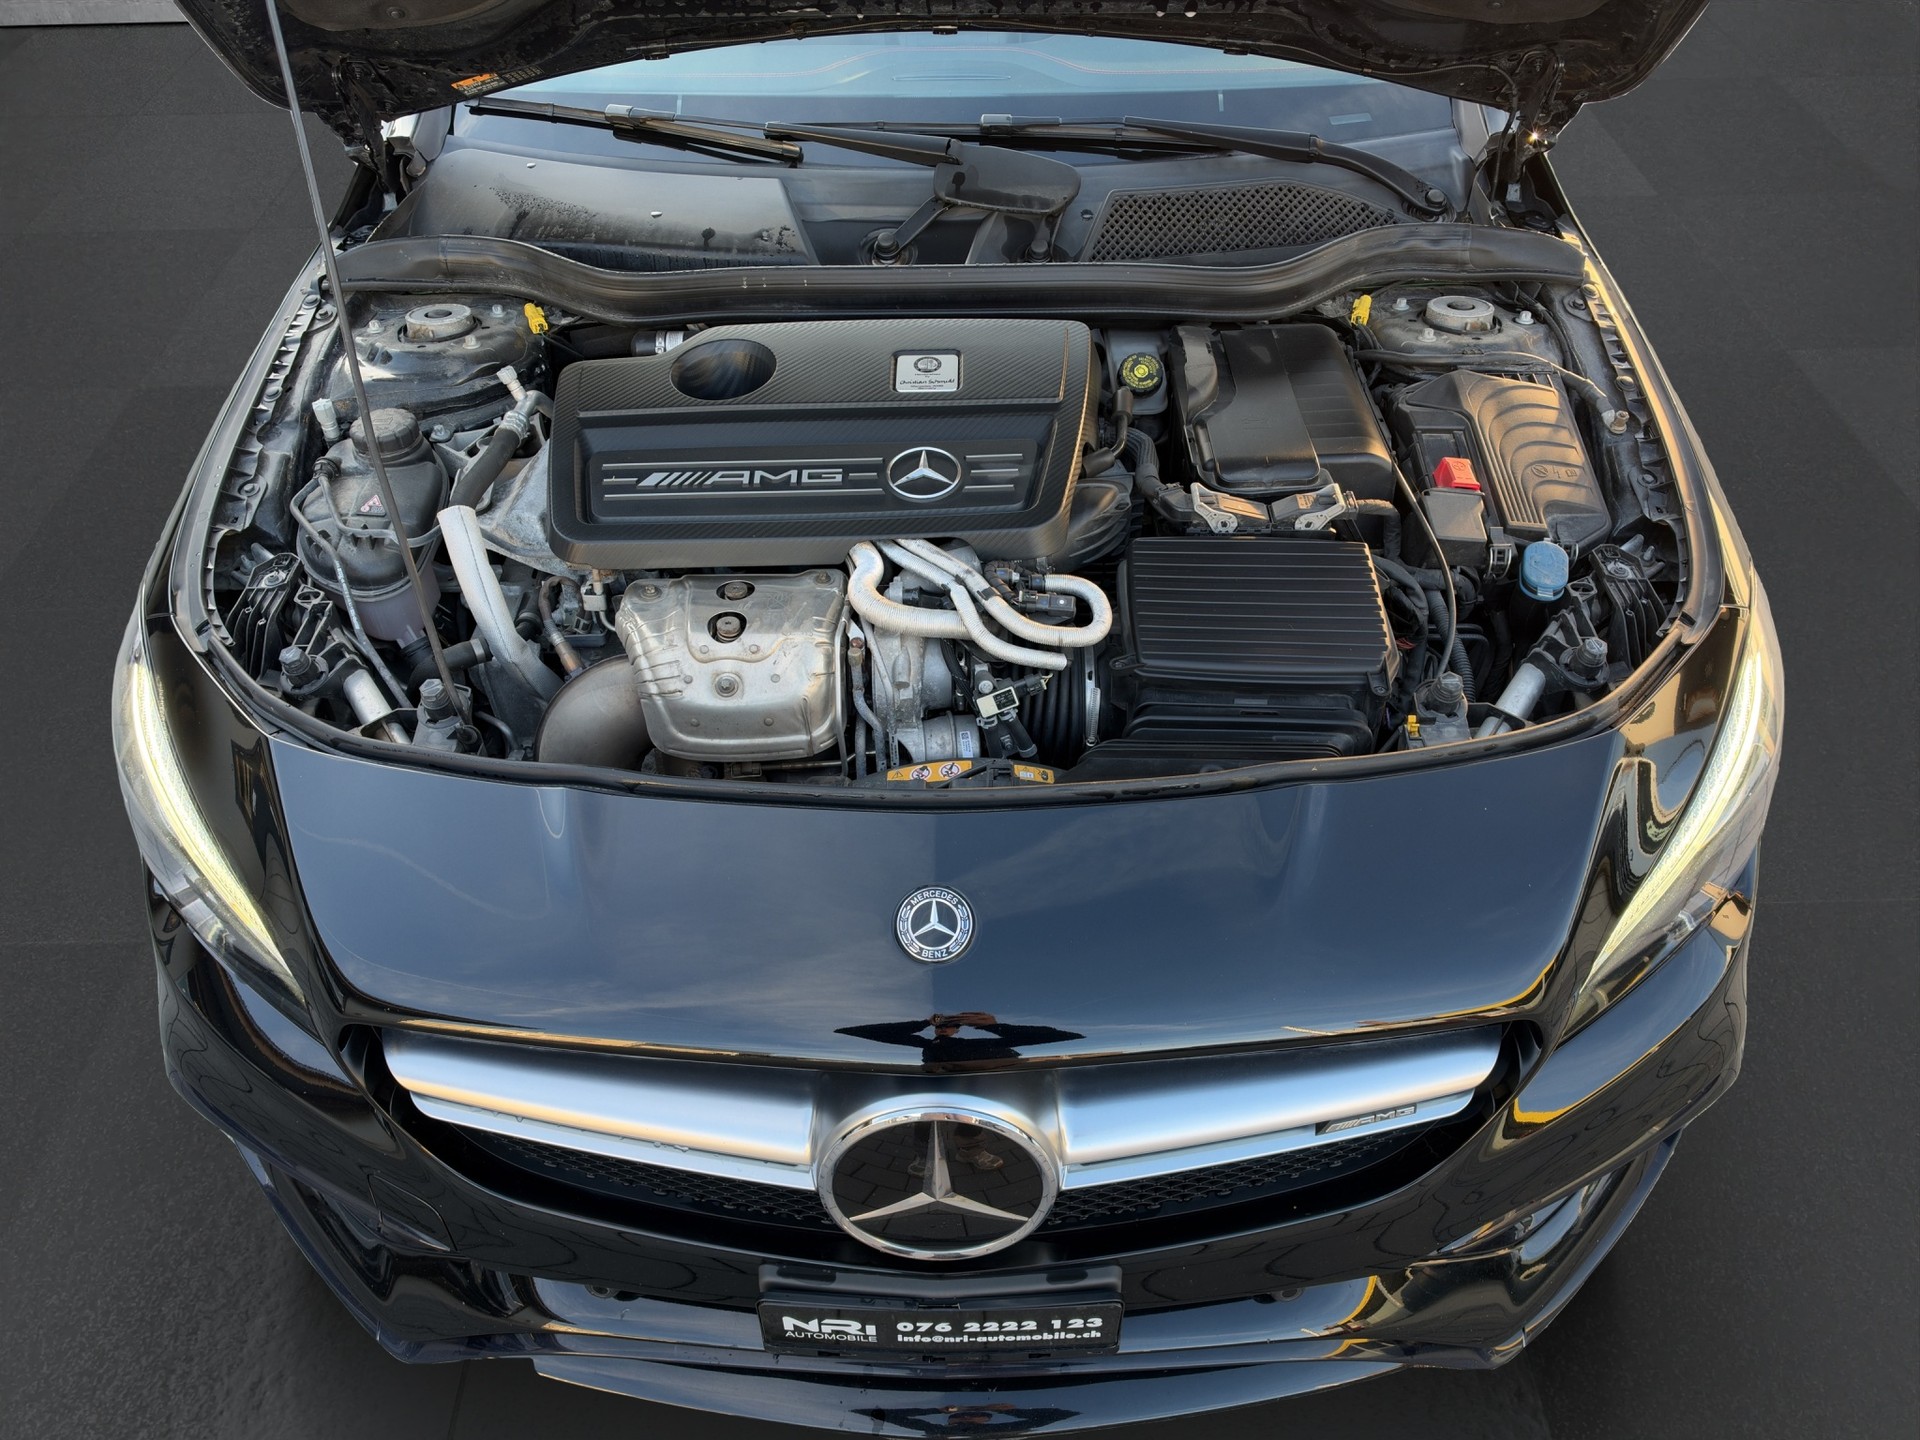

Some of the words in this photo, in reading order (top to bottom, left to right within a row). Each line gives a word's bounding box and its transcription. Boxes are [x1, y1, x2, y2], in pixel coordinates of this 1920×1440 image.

[702, 468, 844, 488] AMG
[910, 890, 959, 906] MERCEDES
[921, 948, 949, 959] BENZ
[1352, 1105, 1415, 1127] AMG
[896, 1321, 953, 1333] 076
[962, 1320, 1038, 1333] 2222
[1051, 1317, 1104, 1330] 123
[785, 1330, 878, 1343] AUTOMOBILE
[897, 1330, 1102, 1343] info@nri-automobile.ch
